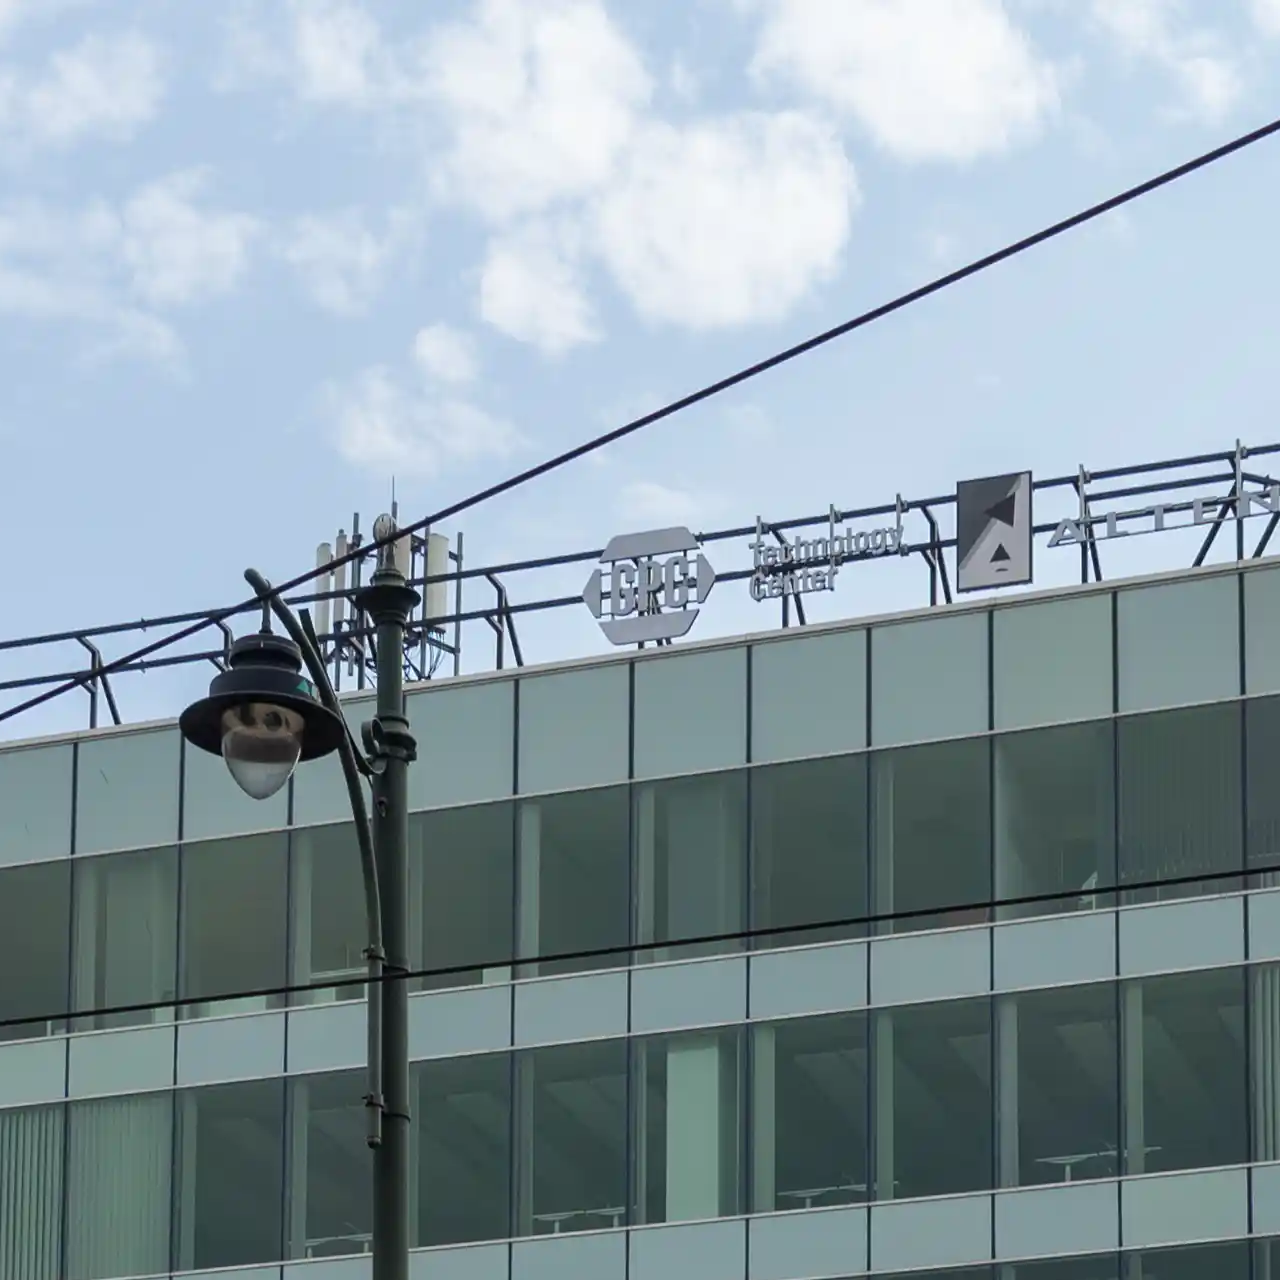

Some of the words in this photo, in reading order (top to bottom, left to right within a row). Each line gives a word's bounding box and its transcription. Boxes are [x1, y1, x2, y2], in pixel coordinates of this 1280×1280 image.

[1047, 484, 1280, 548] ALTEN
[748, 524, 904, 568] Technology
[748, 566, 839, 602] Center
